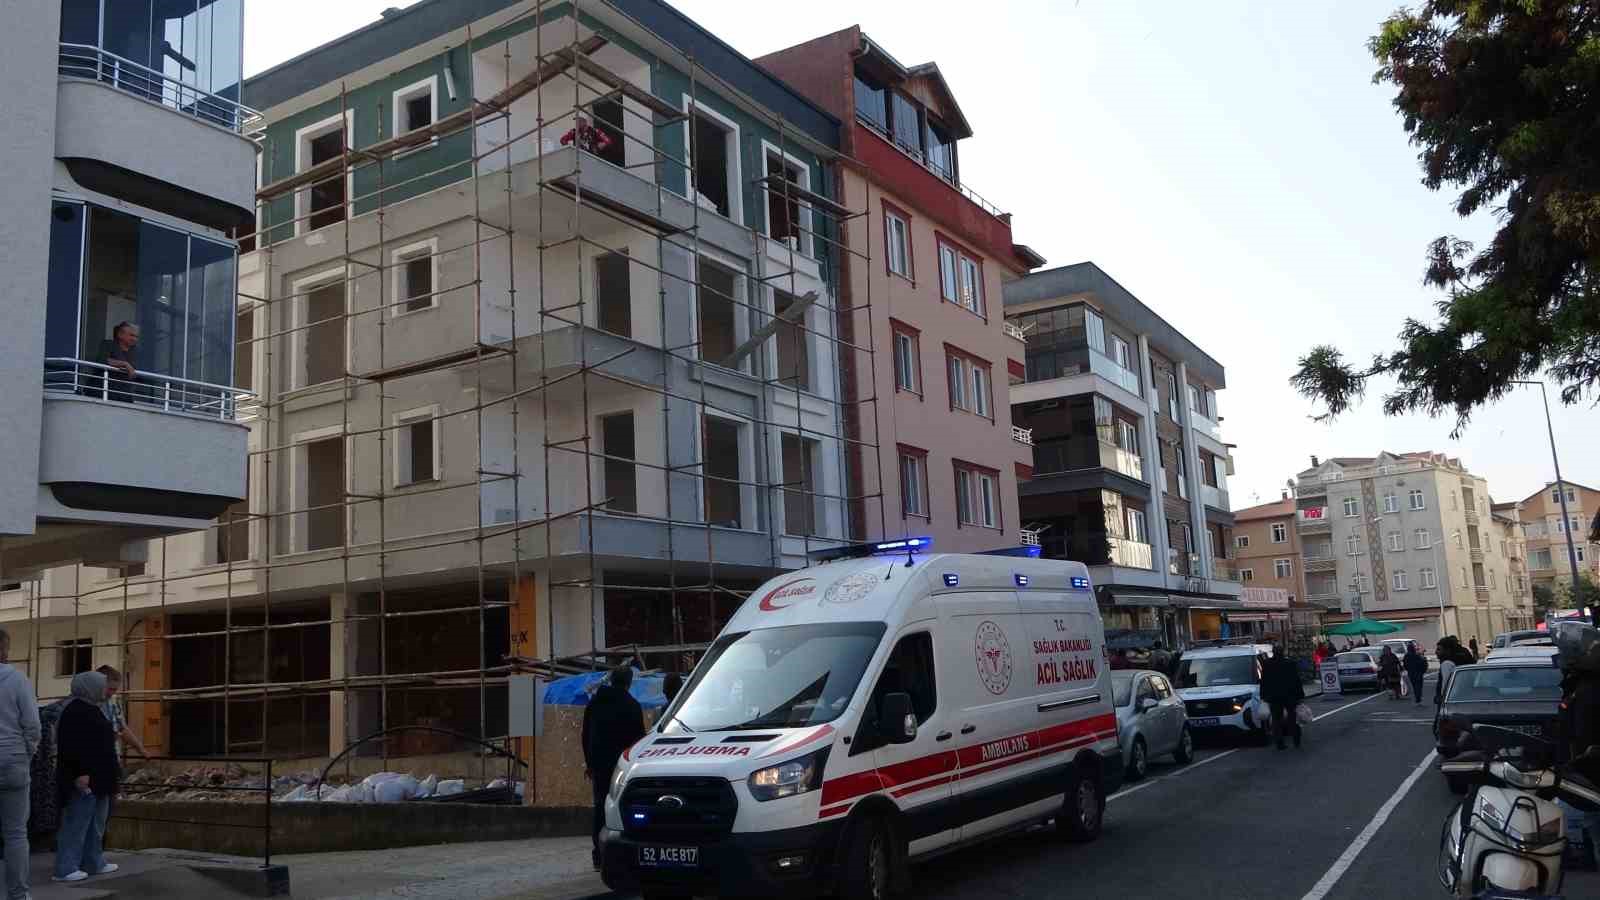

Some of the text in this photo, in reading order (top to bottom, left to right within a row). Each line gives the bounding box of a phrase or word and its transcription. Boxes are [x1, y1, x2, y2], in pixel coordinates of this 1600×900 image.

[1033, 637, 1059, 654] SAĞLIK
[1060, 635, 1092, 652] BAKANLIĞI
[1038, 656, 1096, 685] ACİL SAĞLIK
[982, 736, 1029, 760] AMBULANS
[643, 848, 656, 861] 52
